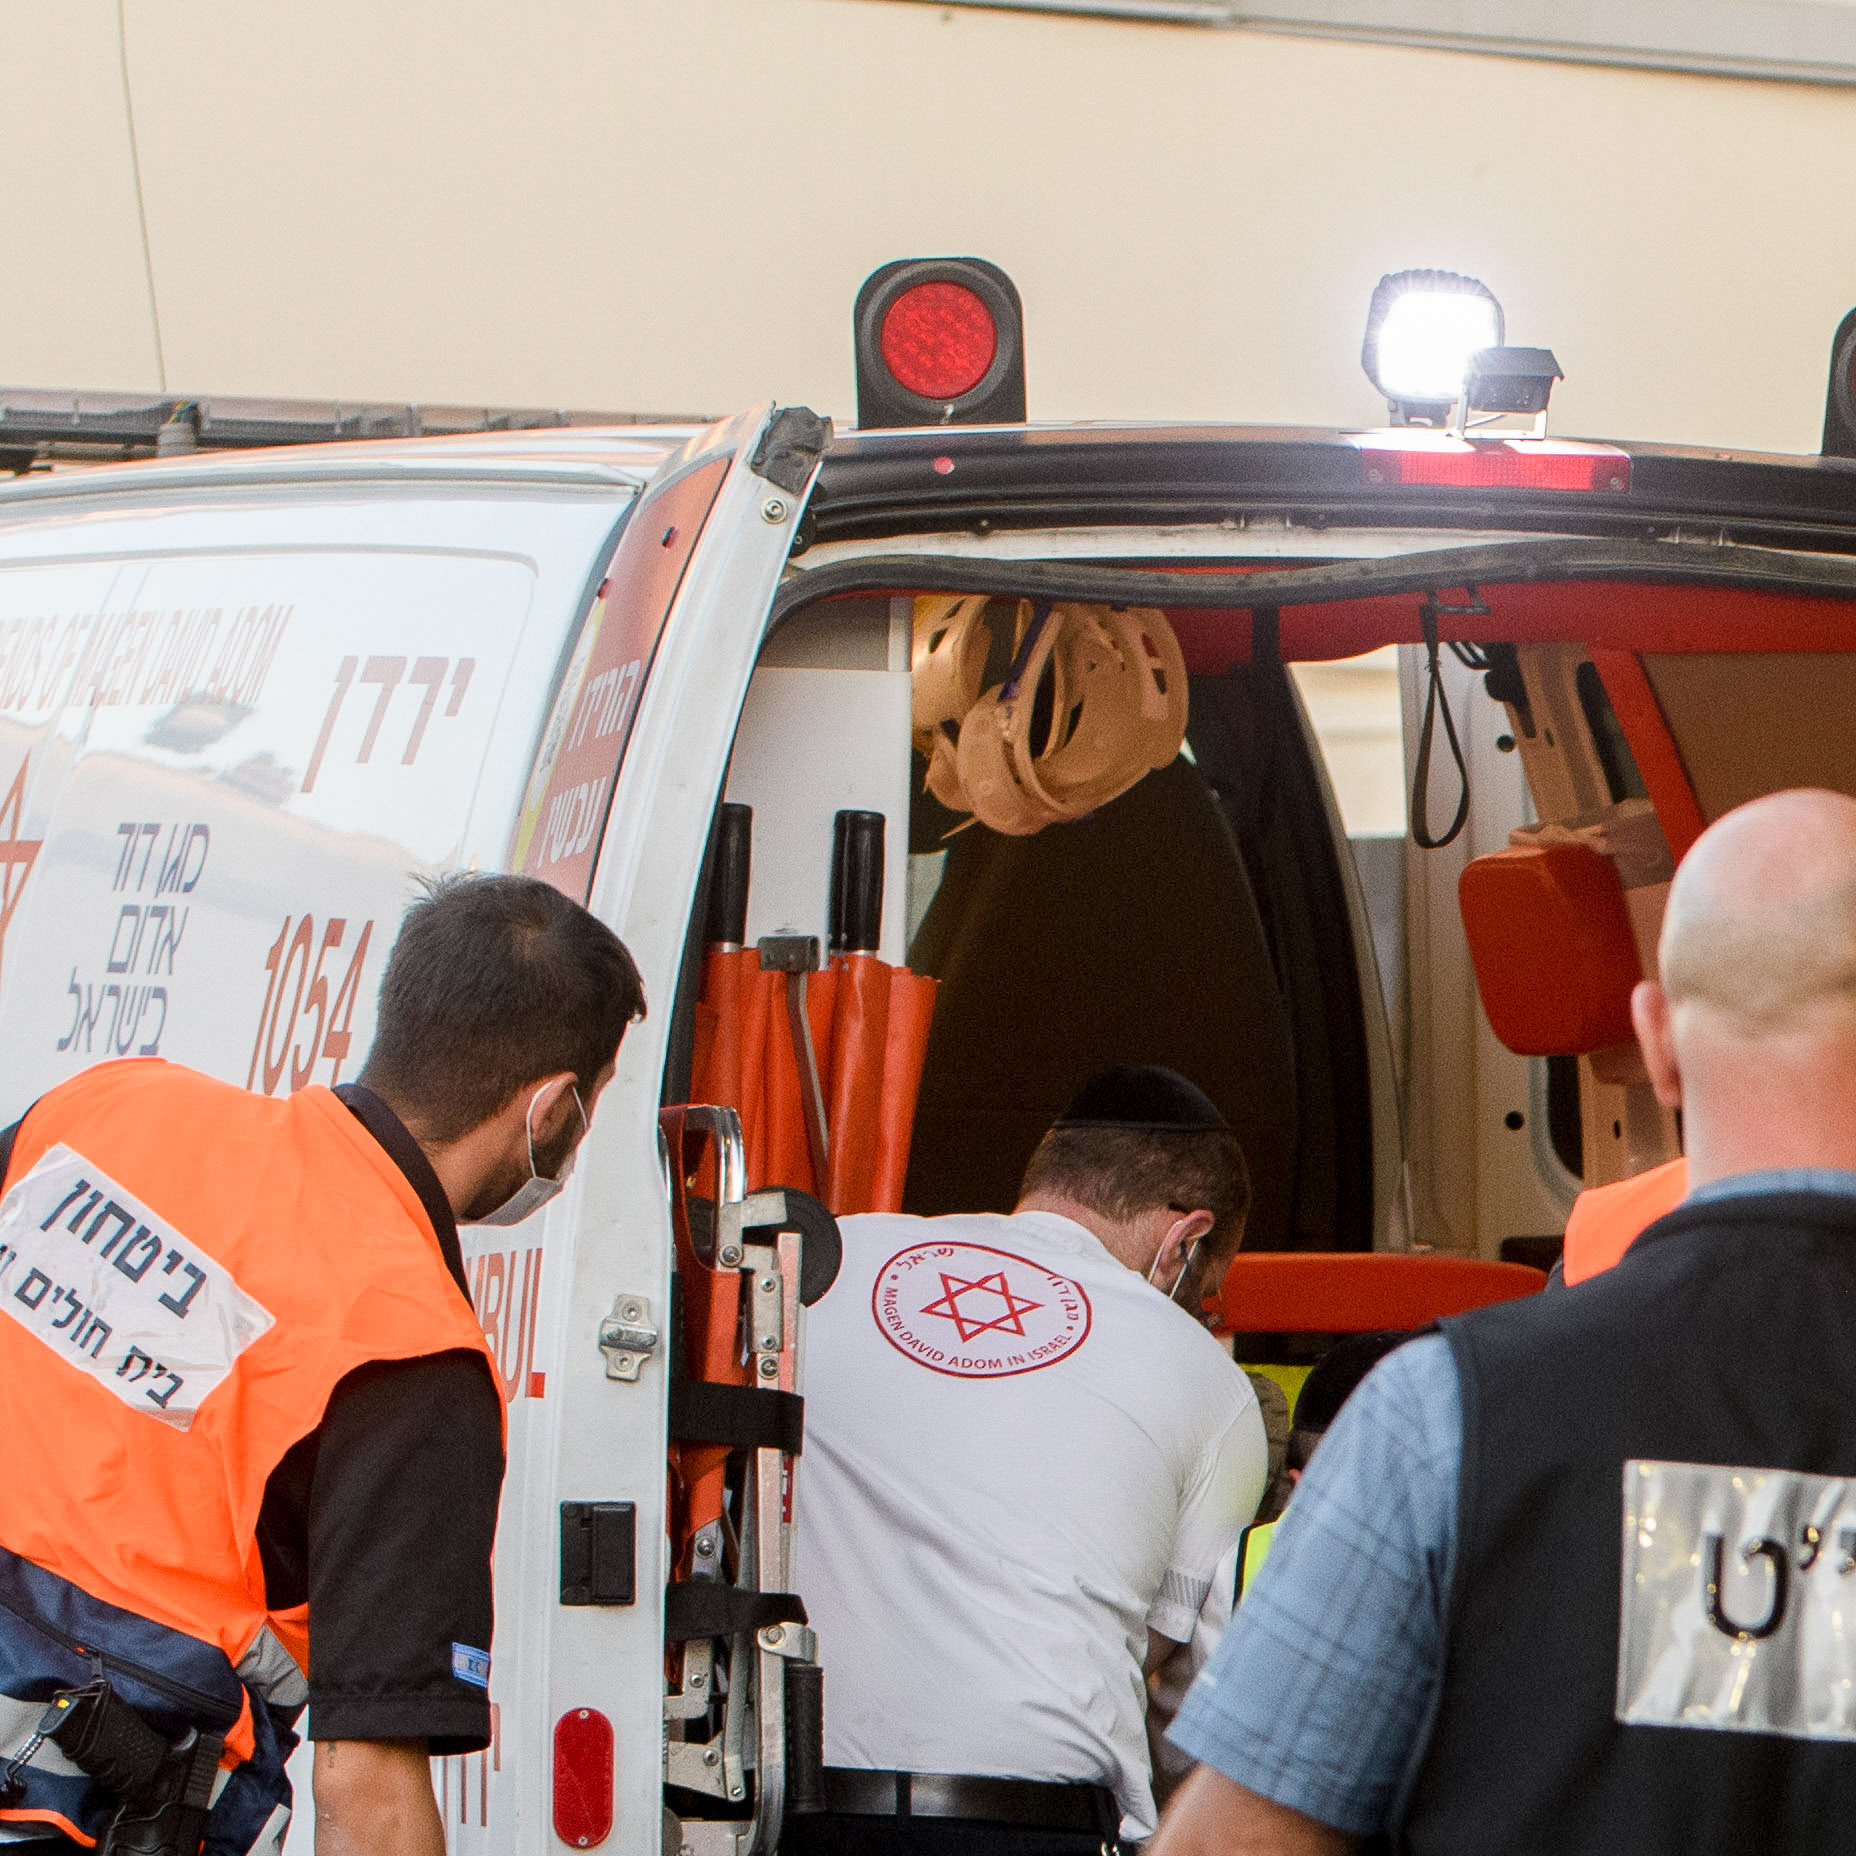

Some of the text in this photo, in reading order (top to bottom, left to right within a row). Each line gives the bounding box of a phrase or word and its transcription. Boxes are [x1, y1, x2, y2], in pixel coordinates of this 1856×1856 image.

[137, 606, 224, 705] DAVID
[203, 602, 296, 704] ADOM
[301, 656, 477, 794] ירדן
[112, 822, 210, 898] מגן דוד
[106, 904, 189, 976] אדום
[56, 966, 168, 1056] בישראל
[247, 912, 374, 1097] 1054
[40, 1178, 207, 1319] ביטחון
[14, 1265, 114, 1359] חולים
[884, 1286, 1074, 1370] MAGEN DAVID ADOM IN ISRAEL
